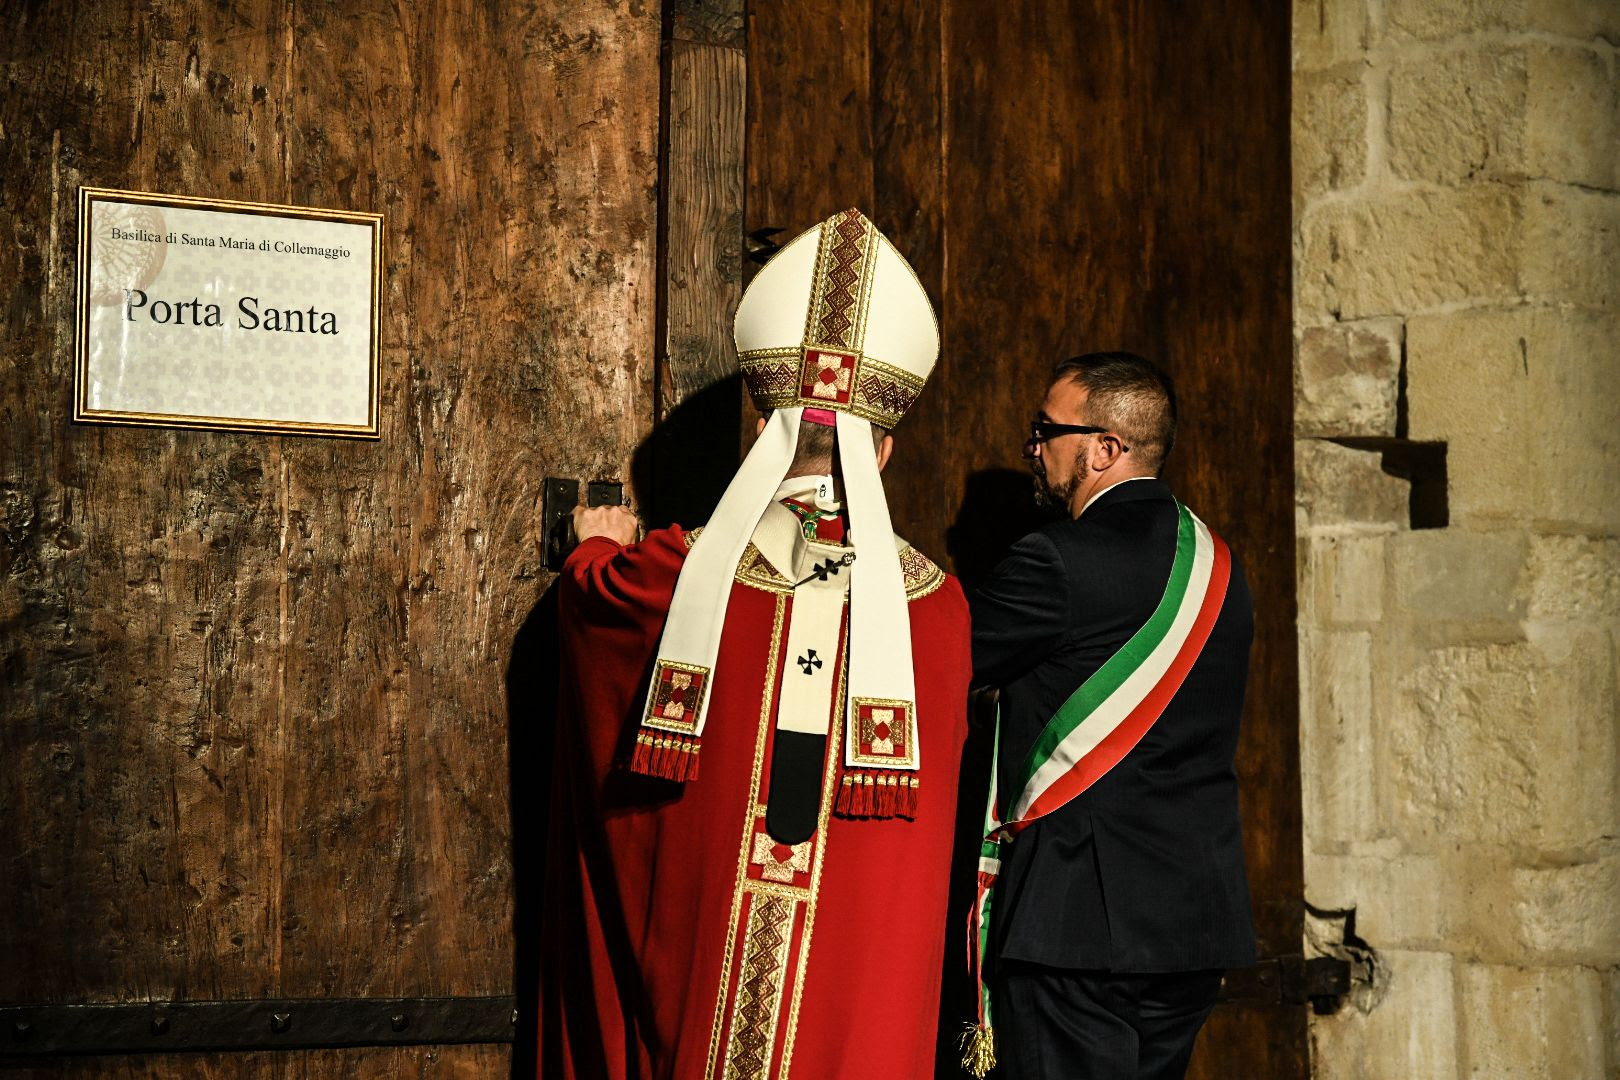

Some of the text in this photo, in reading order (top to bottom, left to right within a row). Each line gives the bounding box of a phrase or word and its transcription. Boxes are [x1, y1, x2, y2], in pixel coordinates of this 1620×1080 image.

[111, 227, 351, 259] Basilica di Santa Maria di Collemaggio
[122, 288, 340, 336] Porta Santa
